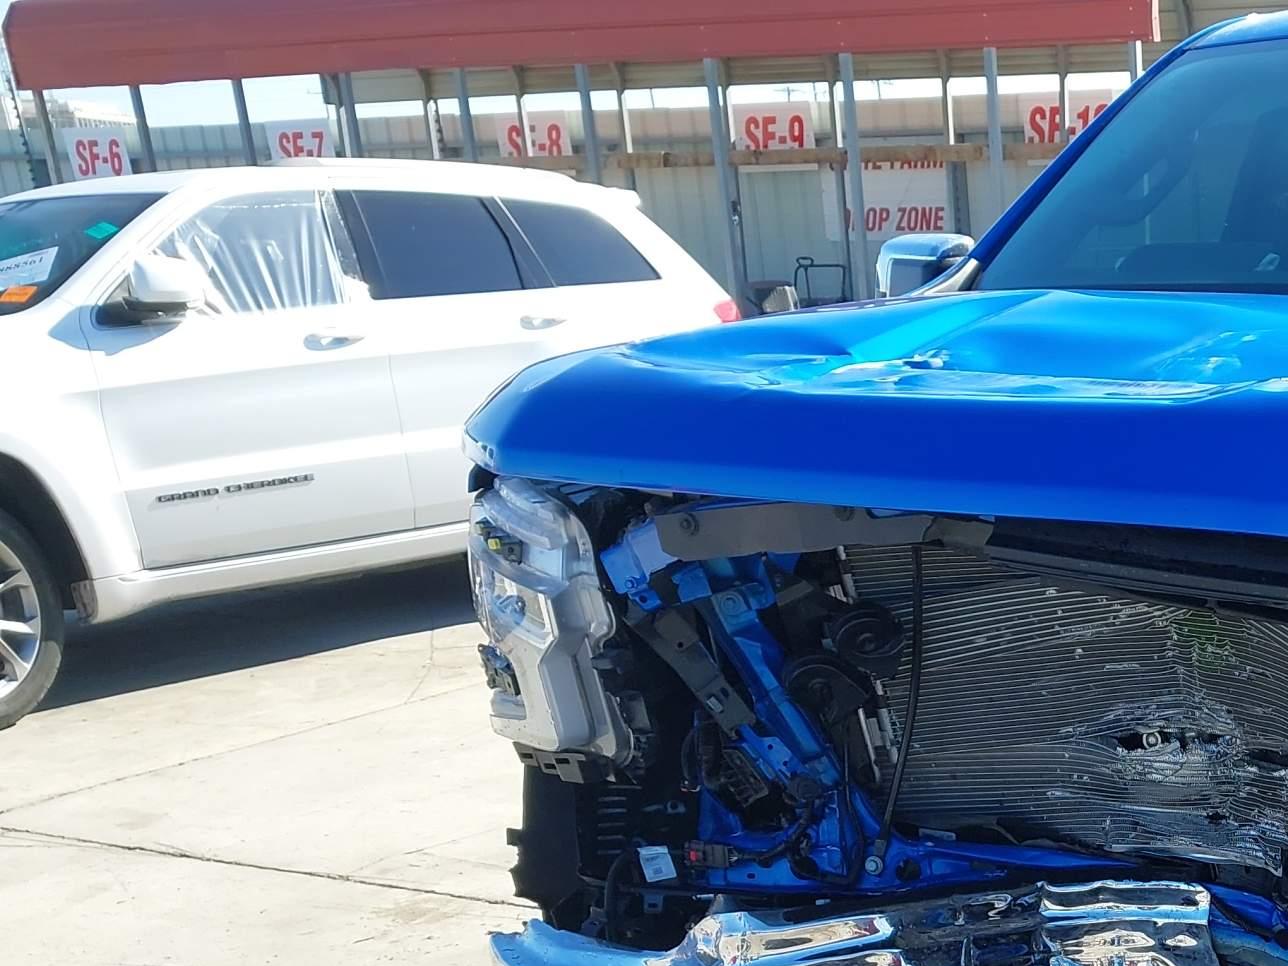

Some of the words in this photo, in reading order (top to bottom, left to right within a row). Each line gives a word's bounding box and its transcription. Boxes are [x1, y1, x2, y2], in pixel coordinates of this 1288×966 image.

[278, 131, 324, 157] SF-7
[745, 115, 804, 150] SF-9
[75, 138, 122, 176] SF-6
[896, 206, 944, 231] ZONE
[157, 487, 219, 502] GRAND
[223, 473, 314, 494] CHEROKEE
